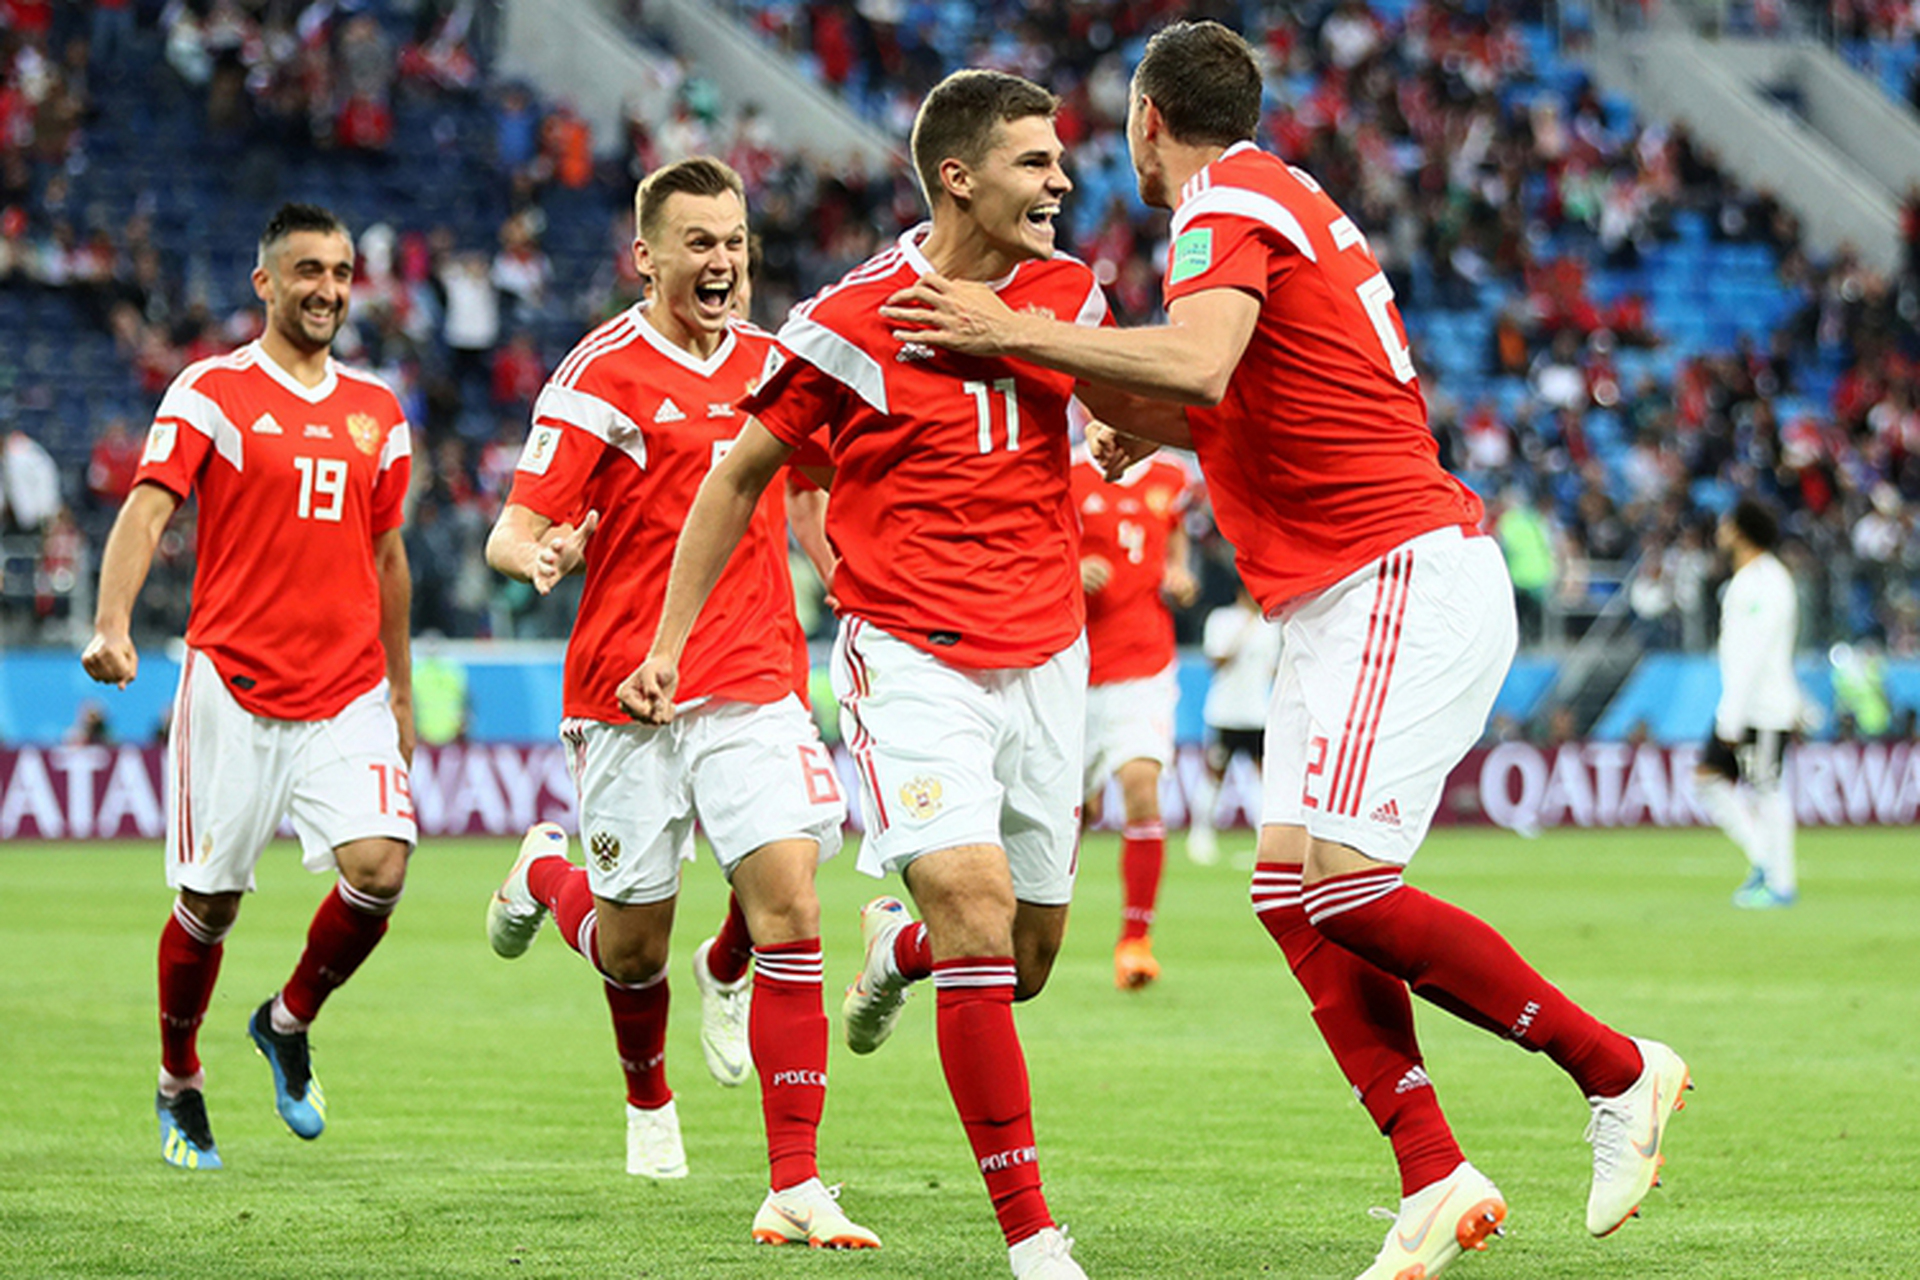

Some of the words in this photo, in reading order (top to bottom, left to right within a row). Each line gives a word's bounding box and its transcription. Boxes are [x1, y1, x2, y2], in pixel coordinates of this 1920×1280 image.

[962, 377, 1020, 454] 11
[294, 456, 348, 522] 19
[1118, 519, 1144, 564] 4
[0, 743, 168, 839] ATA
[408, 743, 581, 836] WAYS
[798, 744, 841, 805] 6
[1302, 736, 1328, 809] 2
[1479, 741, 1714, 838] QATAR
[980, 1146, 1038, 1174] РОССИ
